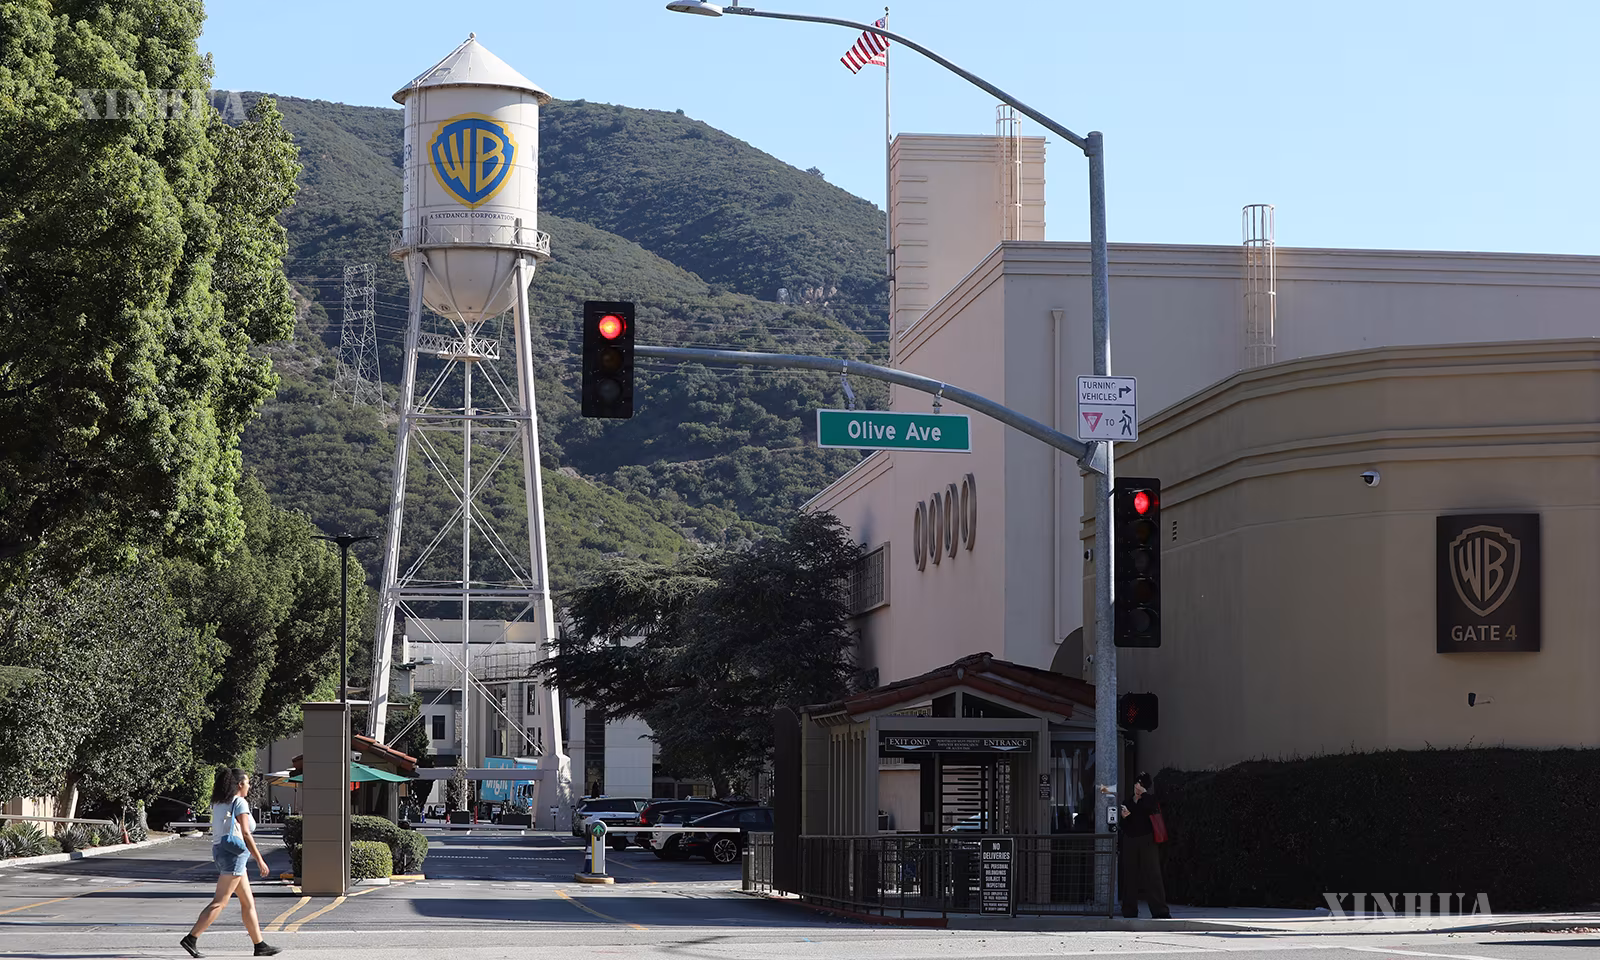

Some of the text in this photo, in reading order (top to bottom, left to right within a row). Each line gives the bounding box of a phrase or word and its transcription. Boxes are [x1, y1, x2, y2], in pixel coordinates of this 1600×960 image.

[437, 127, 505, 193] WB
[1083, 381, 1116, 390] TURNING
[1081, 392, 1117, 401] VEHICLES
[1105, 418, 1115, 427] TO
[848, 419, 942, 441] Olive Ave
[1458, 537, 1507, 602] WB
[1451, 624, 1518, 642] GATE 4
[889, 738, 908, 746] EXIT
[910, 738, 932, 747] ONLY
[983, 739, 1028, 747] ENTRANCE
[992, 842, 1000, 850] NO
[982, 852, 1010, 860] DELIVERIES
